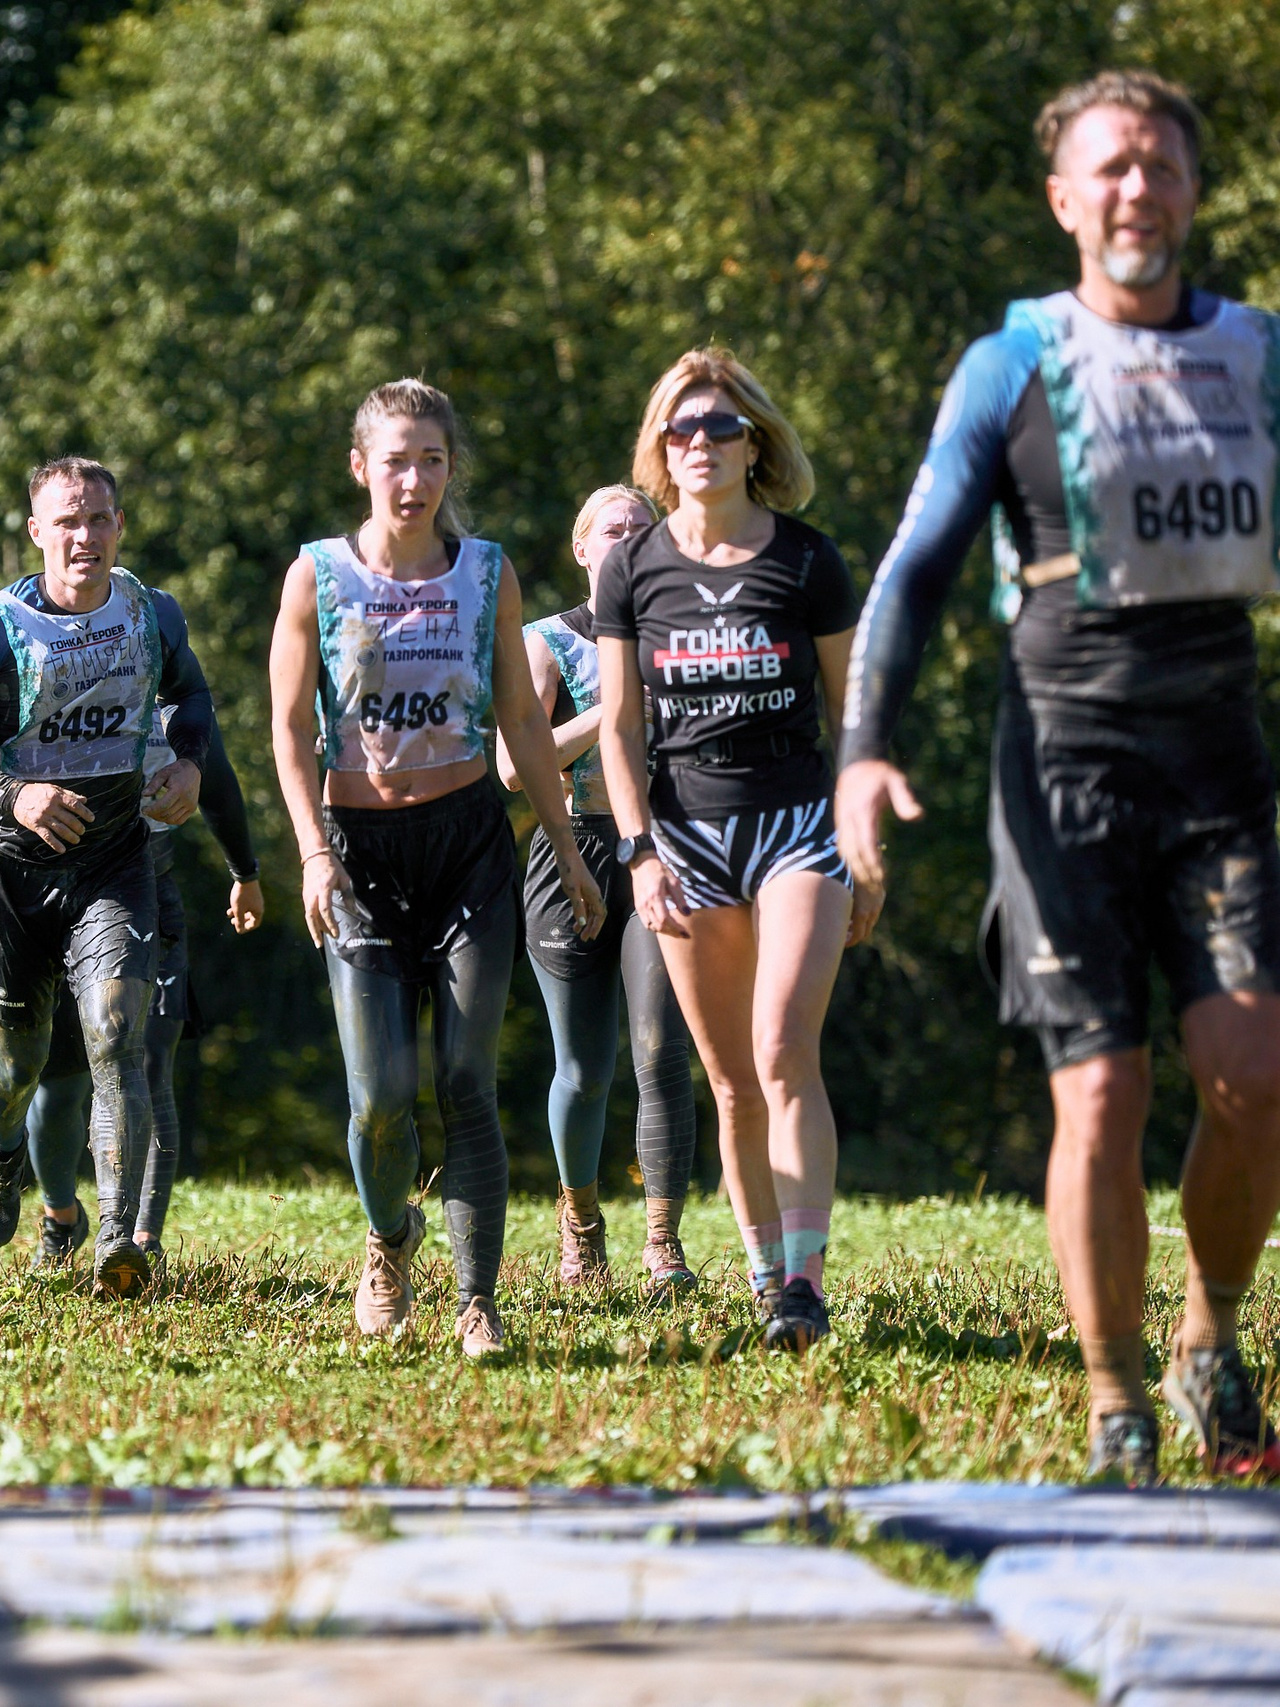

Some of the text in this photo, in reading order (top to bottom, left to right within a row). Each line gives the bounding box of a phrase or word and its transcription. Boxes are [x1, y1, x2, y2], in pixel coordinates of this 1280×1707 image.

[1133, 477, 1262, 543] 6490
[365, 600, 459, 613] ГОНКА ГЕРОЕВ
[49, 623, 126, 651] ГОНКА ГЕРОЕВ
[373, 615, 461, 643] ЛЕНА
[670, 625, 774, 657] ГОНКА
[383, 647, 464, 662] ГАЗПРОМБАНК
[662, 652, 782, 686] ГЕРОЕВ
[74, 664, 137, 692] ГАЗПМБАНК
[657, 687, 797, 720] ИНСТРУКТОР
[38, 704, 127, 744] 6492
